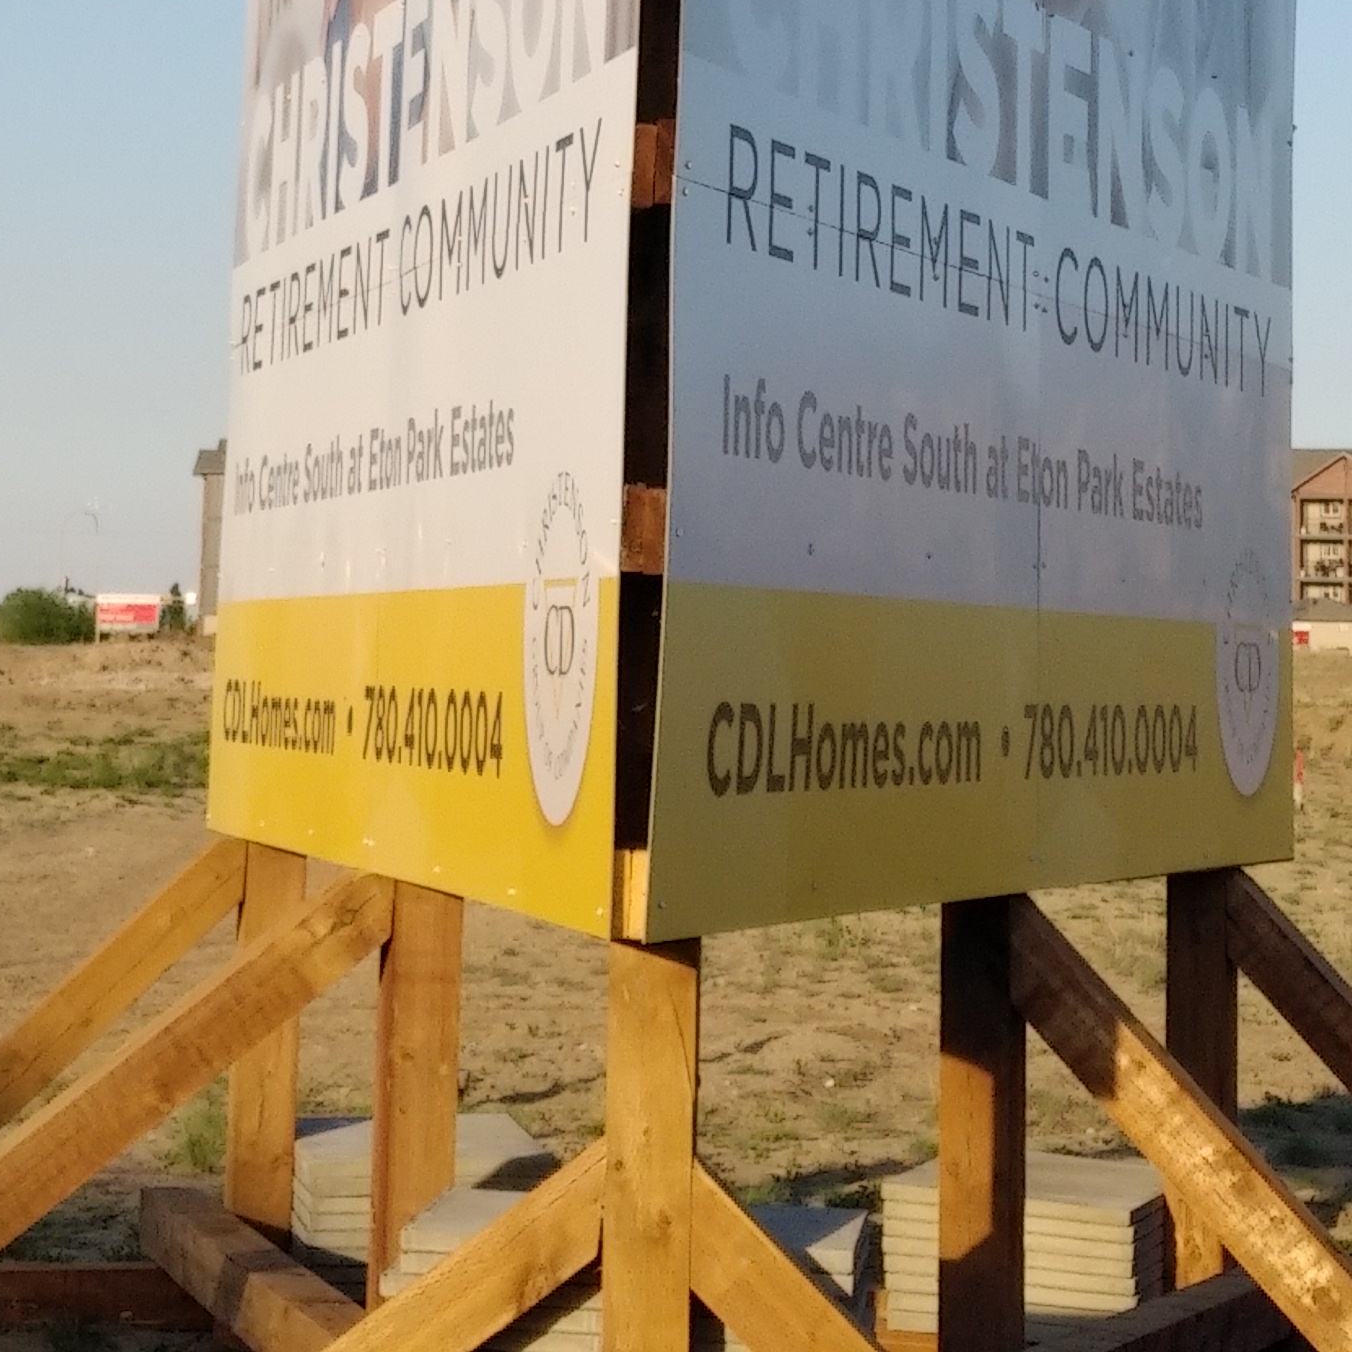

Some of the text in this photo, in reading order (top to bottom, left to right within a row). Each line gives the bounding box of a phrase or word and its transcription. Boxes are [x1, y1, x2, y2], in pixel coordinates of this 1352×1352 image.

[240, 116, 603, 376] RETIREMENT COMMUNITY
[726, 123, 1271, 398] RETIREMENT COMMUNITY
[234, 400, 515, 516] Info Centre South at Eton Park Estates
[722, 375, 1203, 529] Info Centre South at Eton Park Estates
[222, 678, 336, 757] CDLHomes.com
[363, 685, 503, 779] 780.410.0004
[706, 701, 981, 797] CDLHomes.com
[1023, 703, 1198, 780] 780.410.0004
